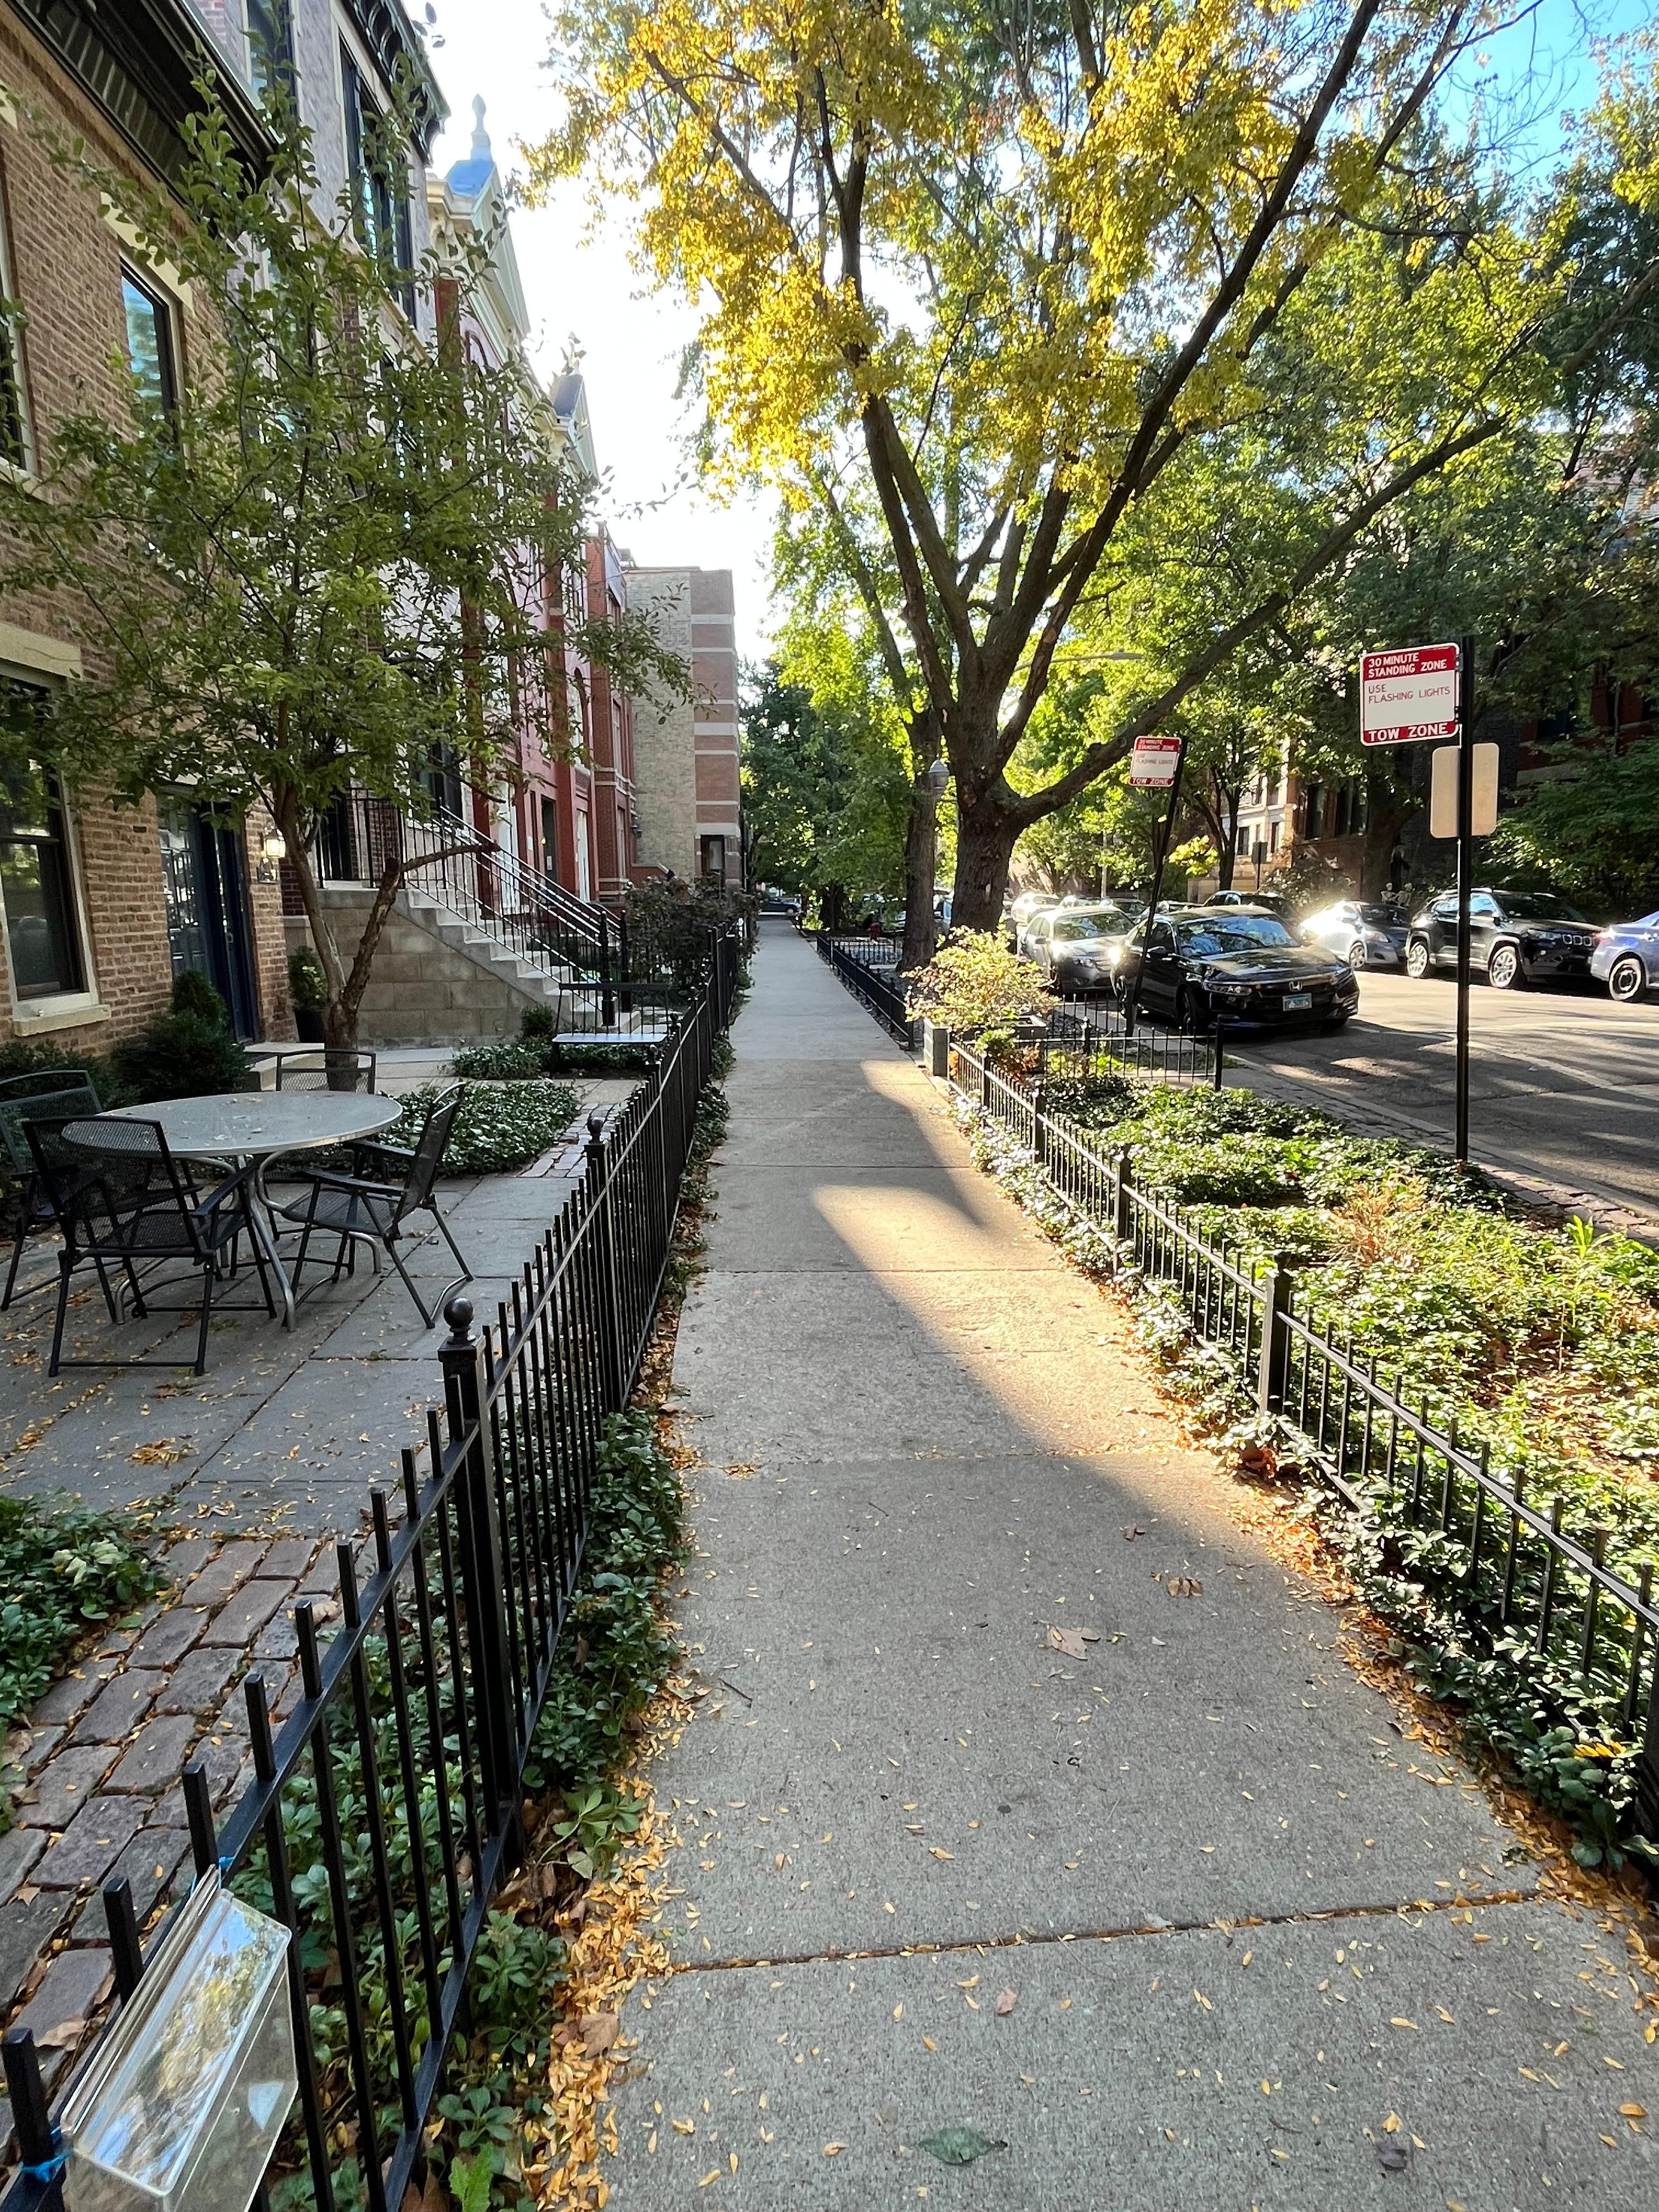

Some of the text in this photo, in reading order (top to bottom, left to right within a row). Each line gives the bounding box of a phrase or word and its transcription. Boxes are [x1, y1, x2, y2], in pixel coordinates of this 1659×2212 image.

[1368, 652, 1419, 668] 30 MINUTE
[1368, 659, 1447, 678] STANDING ZONE
[1368, 684, 1387, 694] USE
[1368, 686, 1451, 704] FLASHING LIGHTS
[1368, 723, 1448, 742] TOW ZONE
